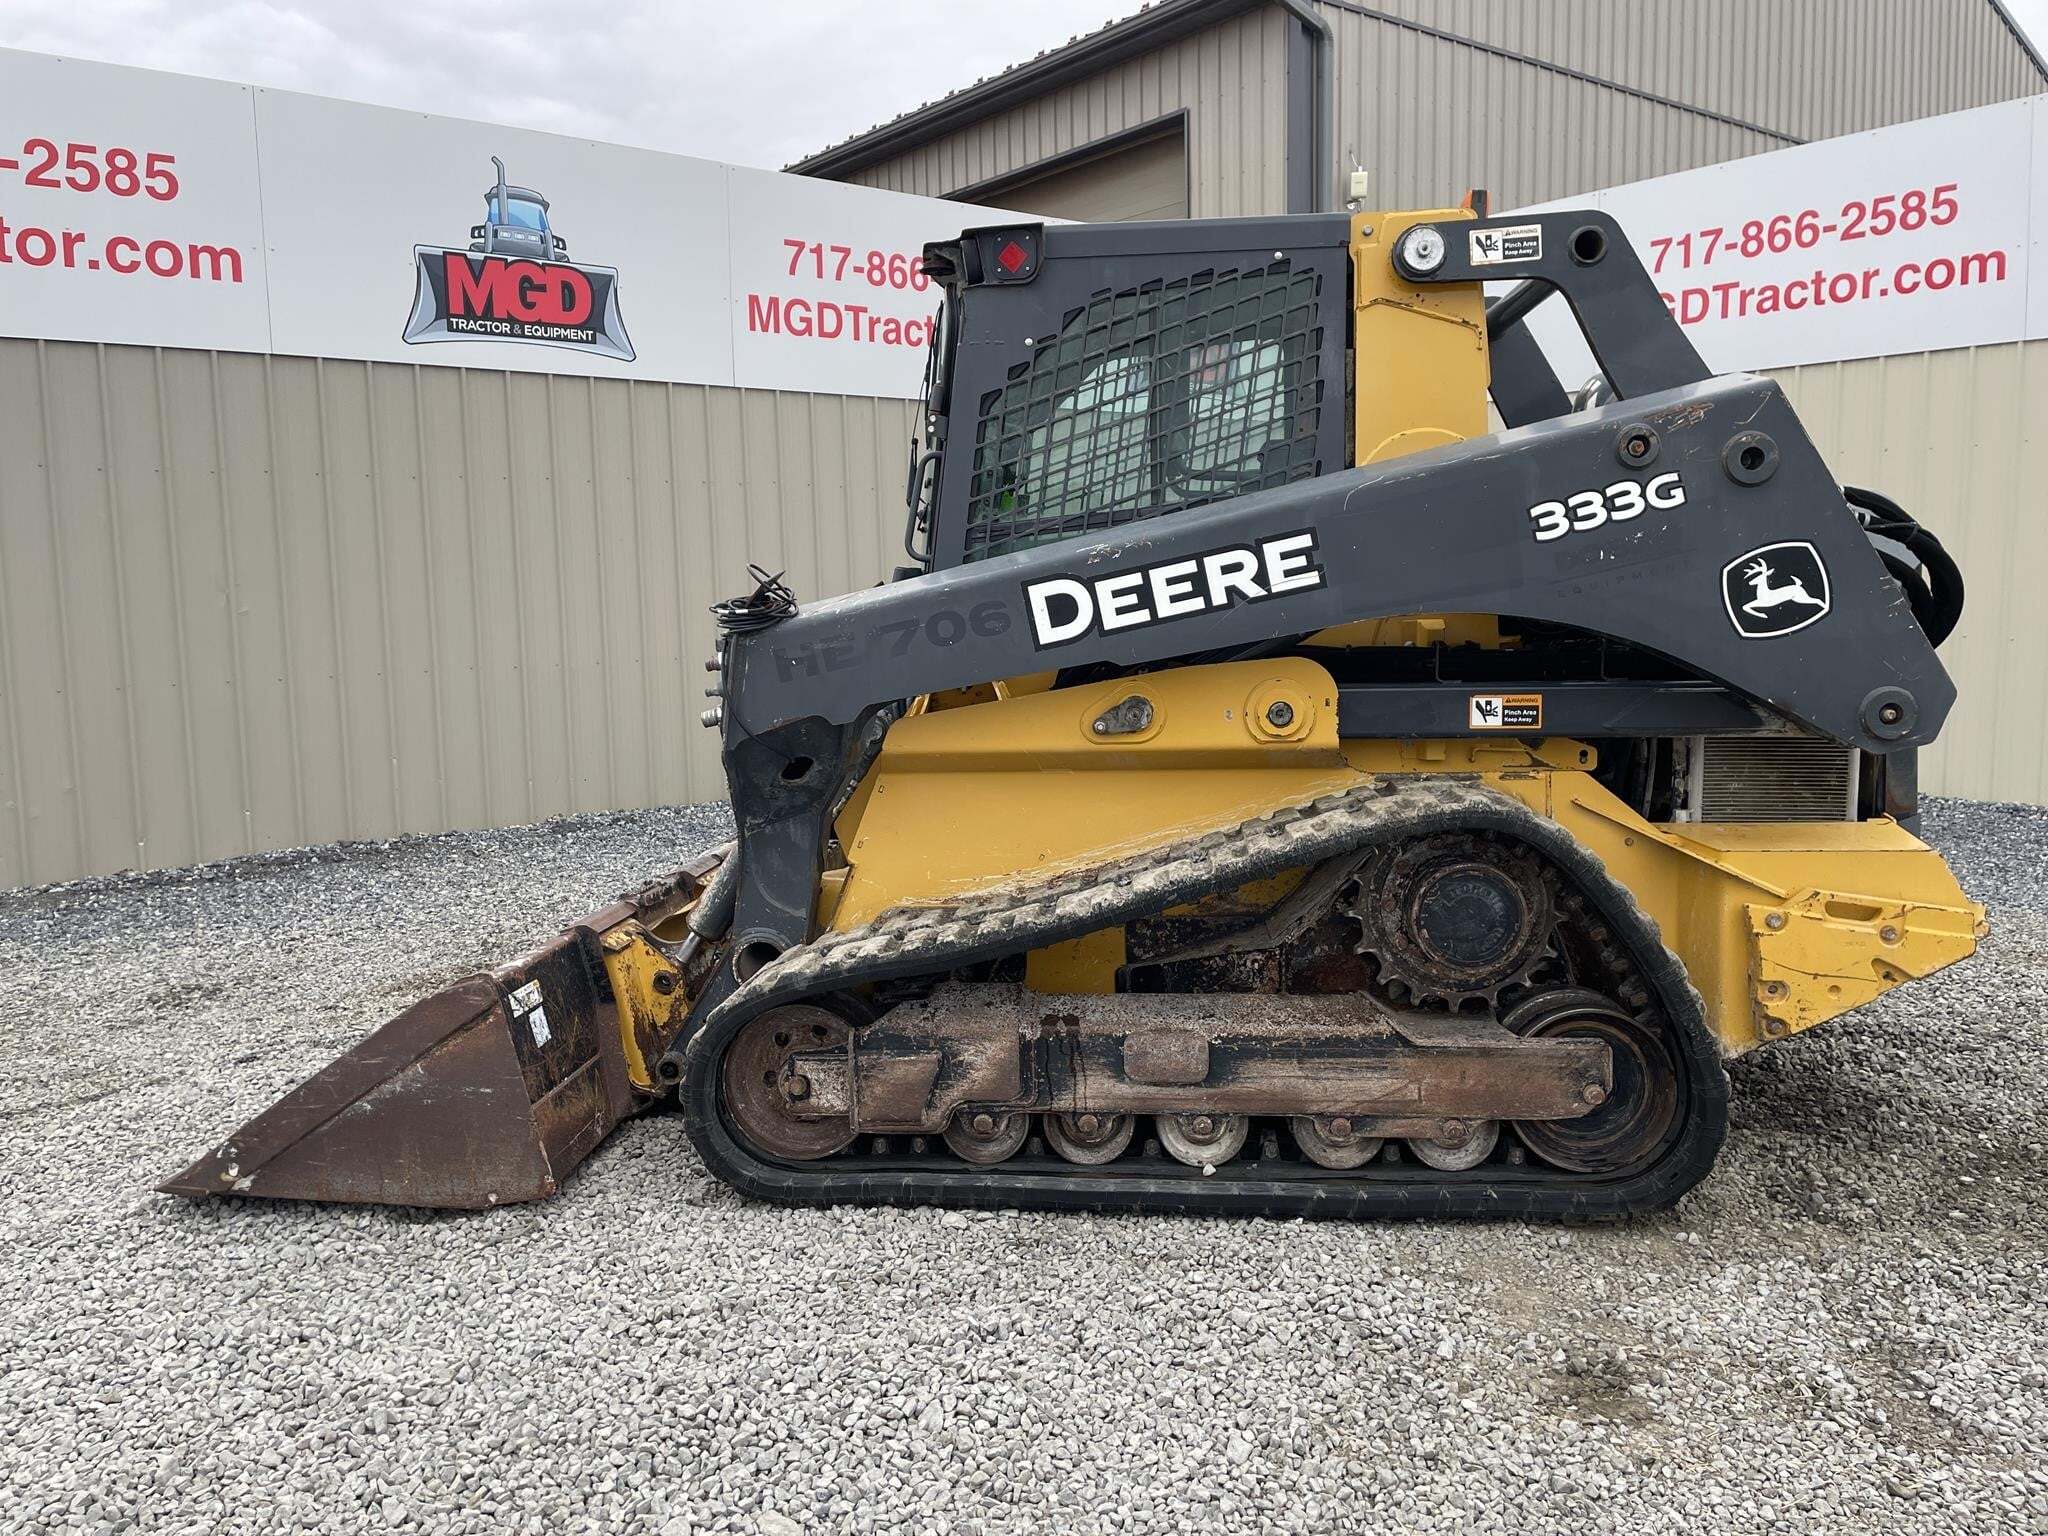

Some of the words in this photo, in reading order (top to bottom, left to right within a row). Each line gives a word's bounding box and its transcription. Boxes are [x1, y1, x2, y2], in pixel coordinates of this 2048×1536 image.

[1650, 183, 1959, 274] 717-866-2585
[445, 253, 592, 325] MGD
[450, 317, 511, 334] TRACTOR
[513, 324, 522, 335] &
[524, 325, 594, 341] EQUIPMENT
[1529, 472, 1686, 541] 333G
[1027, 533, 1321, 646] DEERE
